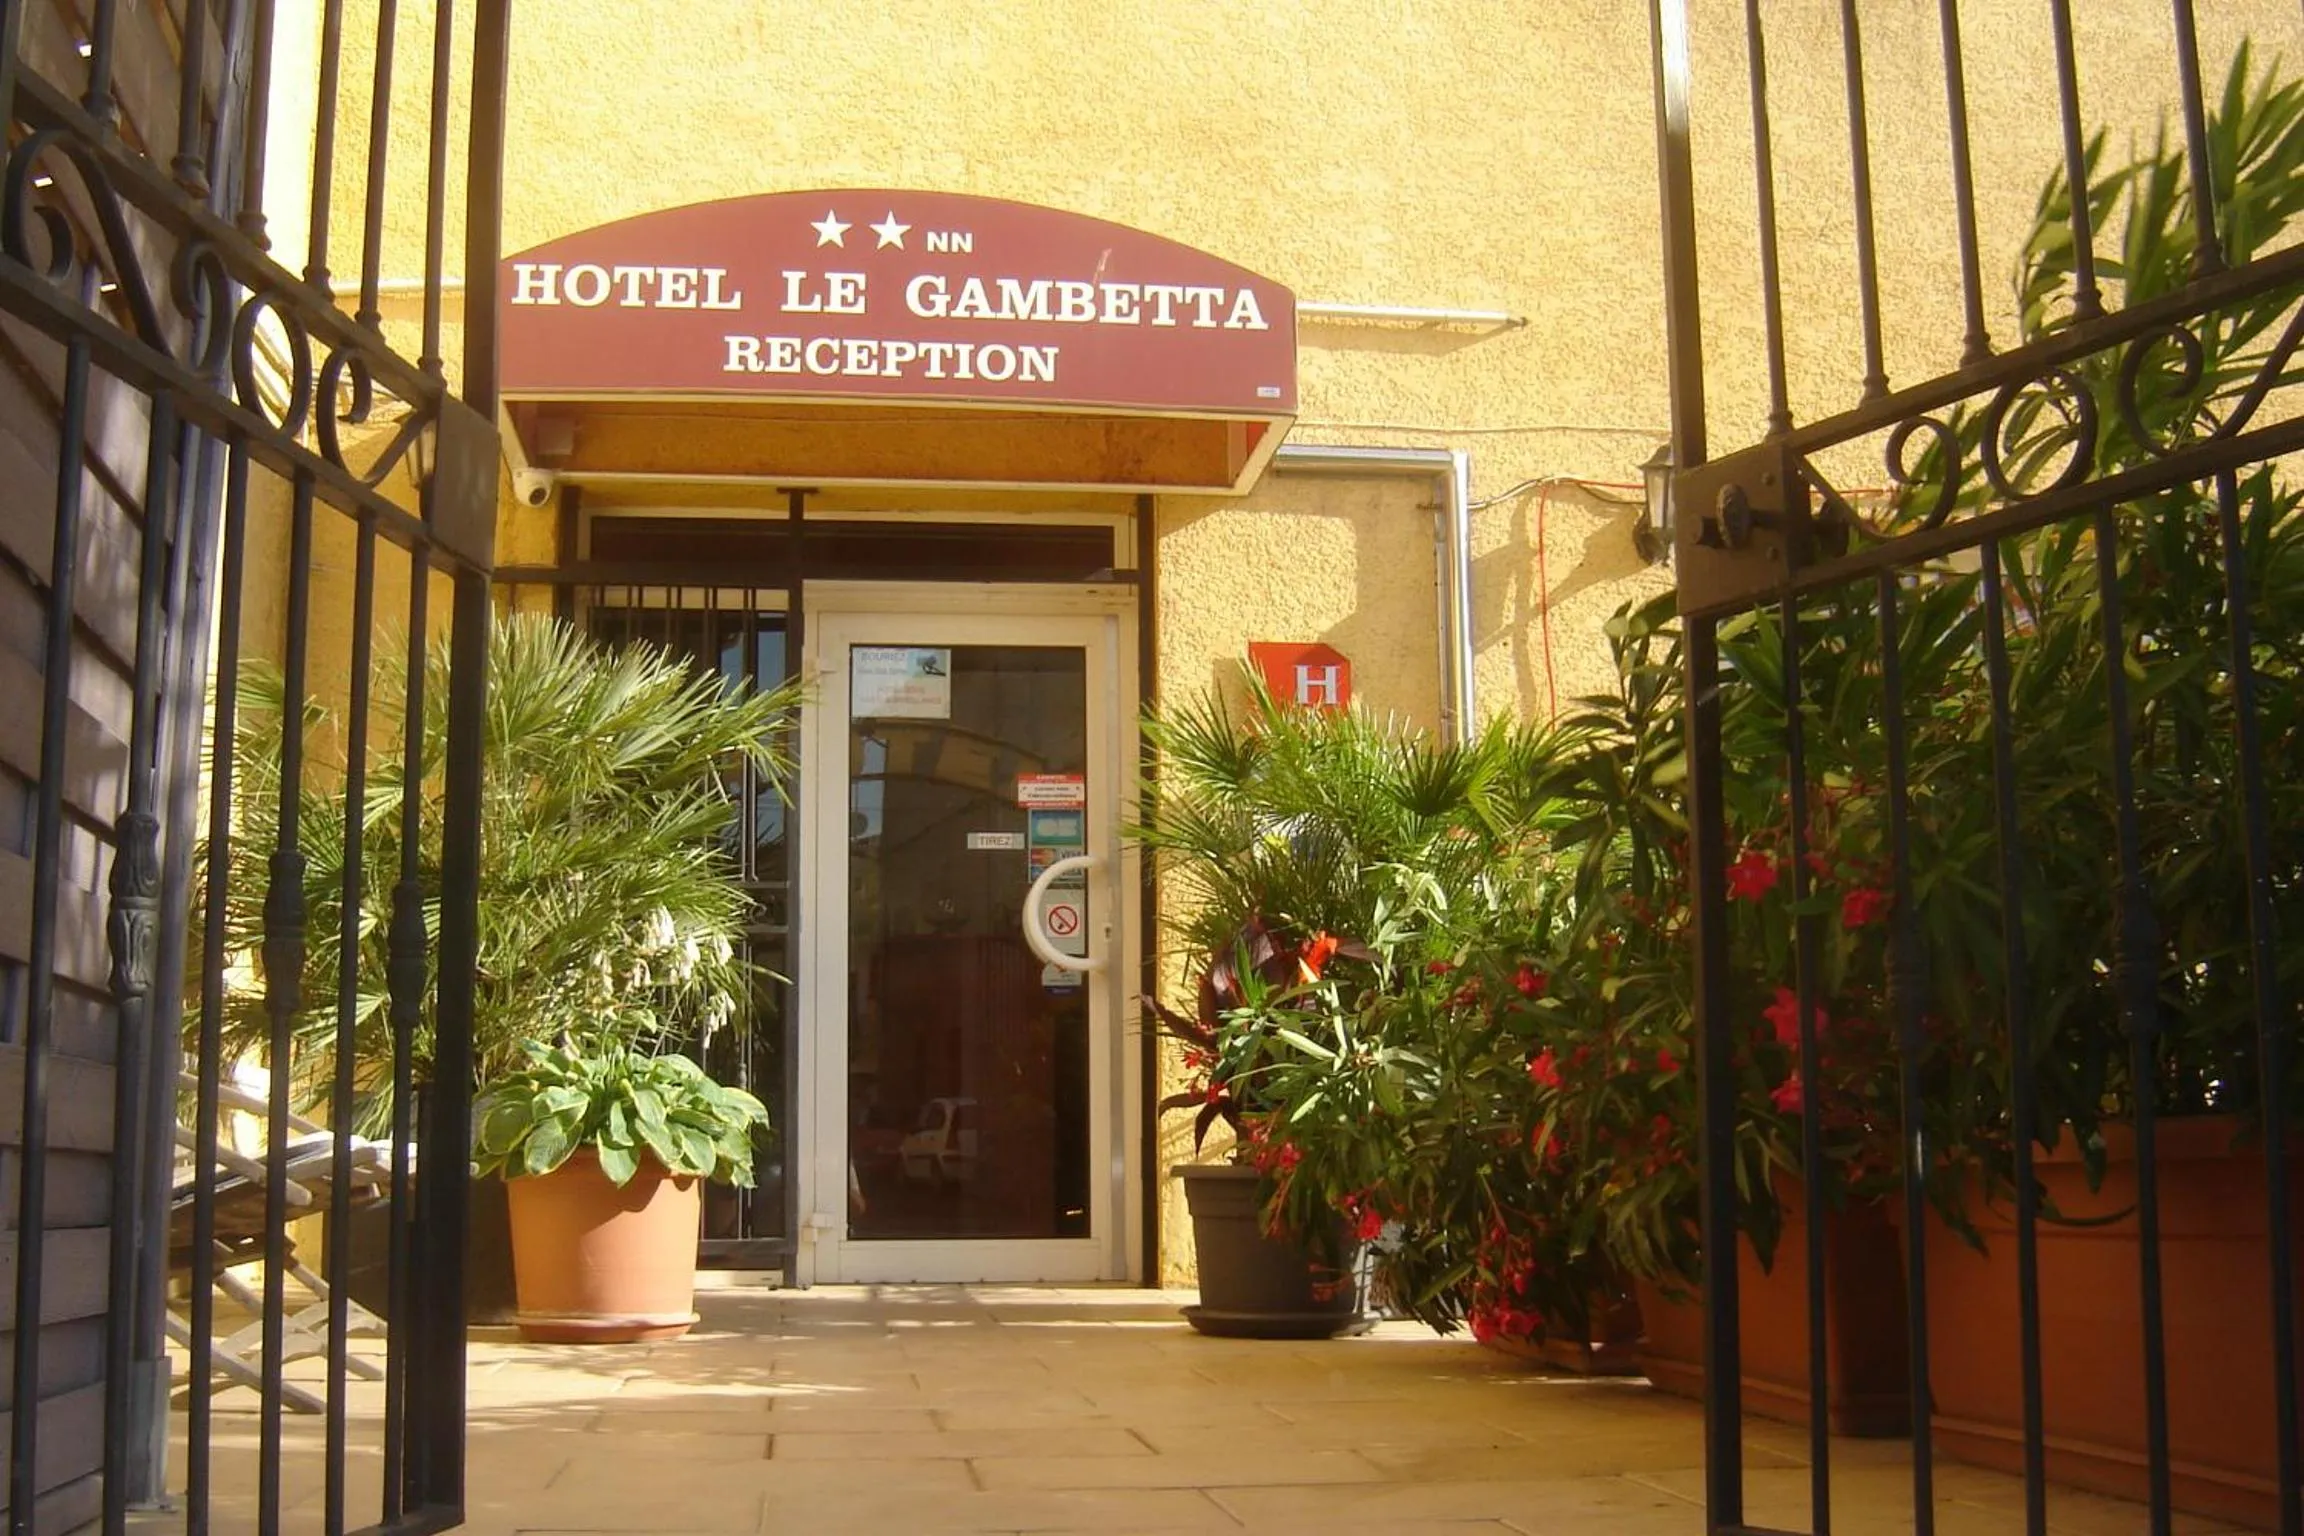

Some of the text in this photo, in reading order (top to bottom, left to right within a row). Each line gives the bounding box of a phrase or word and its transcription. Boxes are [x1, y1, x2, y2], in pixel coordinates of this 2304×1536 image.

[926, 230, 973, 253] NN
[511, 263, 1269, 330] HOTEL LE GAMBETTA
[723, 335, 1059, 382] RECEPTION
[1294, 664, 1341, 704] H
[980, 836, 1010, 846] TIREZ
